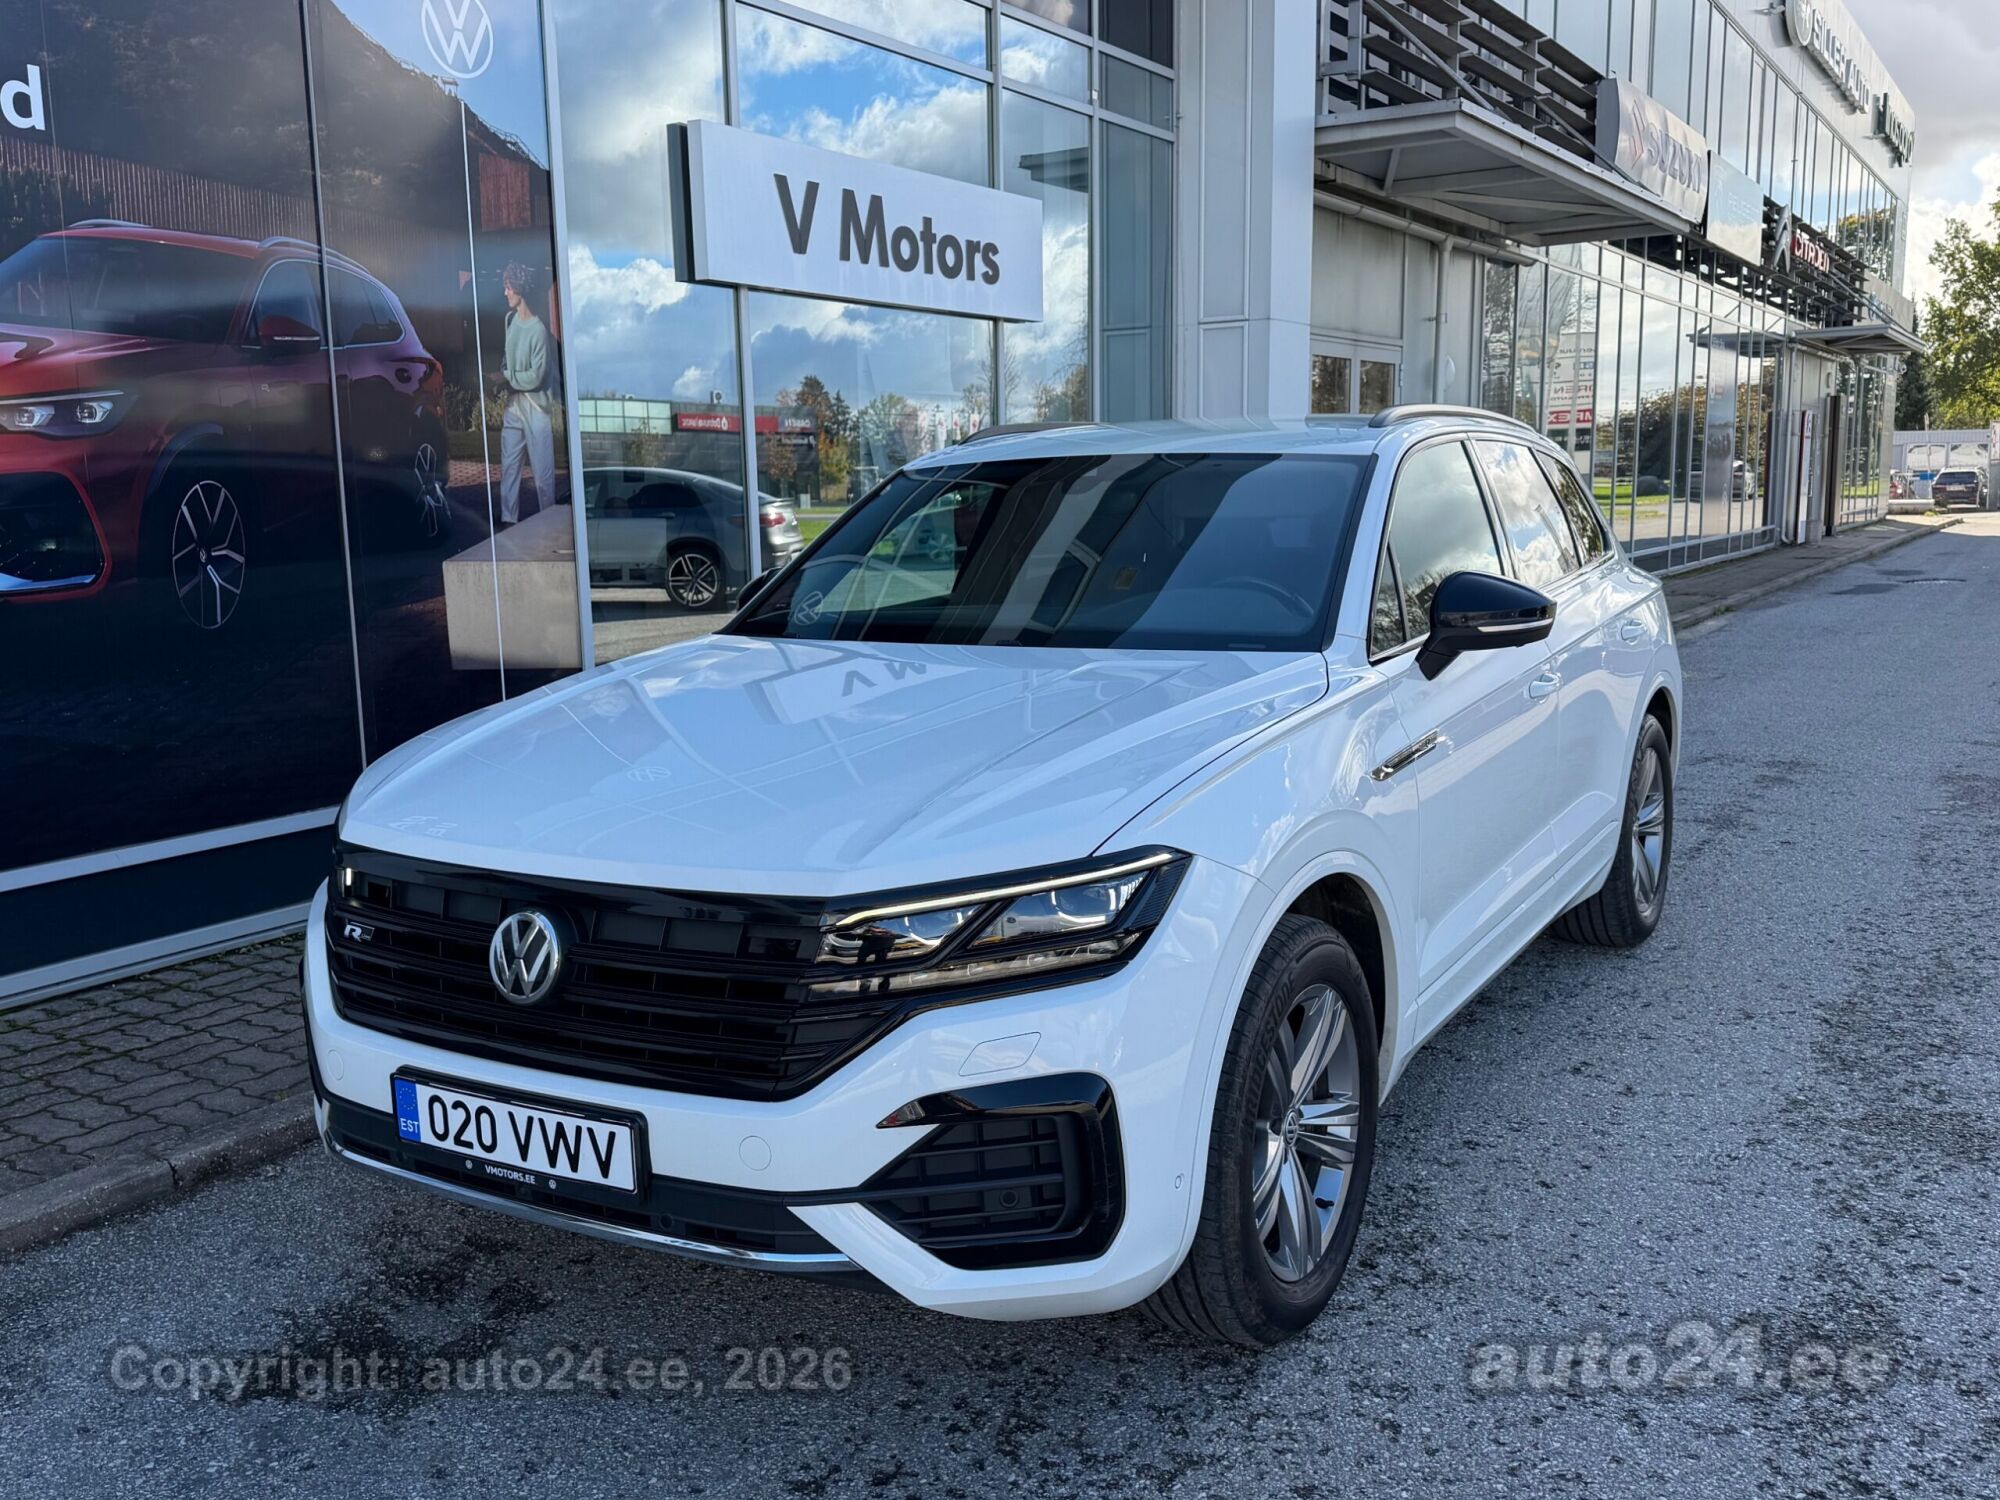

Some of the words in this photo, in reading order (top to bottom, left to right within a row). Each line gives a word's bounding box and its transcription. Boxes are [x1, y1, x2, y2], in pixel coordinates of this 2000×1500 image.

[1647, 122, 1702, 194] SUZUKI
[773, 173, 820, 255] V
[839, 188, 1000, 286] Motors
[400, 1117, 419, 1134] EST
[428, 1094, 498, 1154] 020
[507, 1110, 616, 1179] VWV
[484, 1164, 536, 1185] VMOTORS.EE
